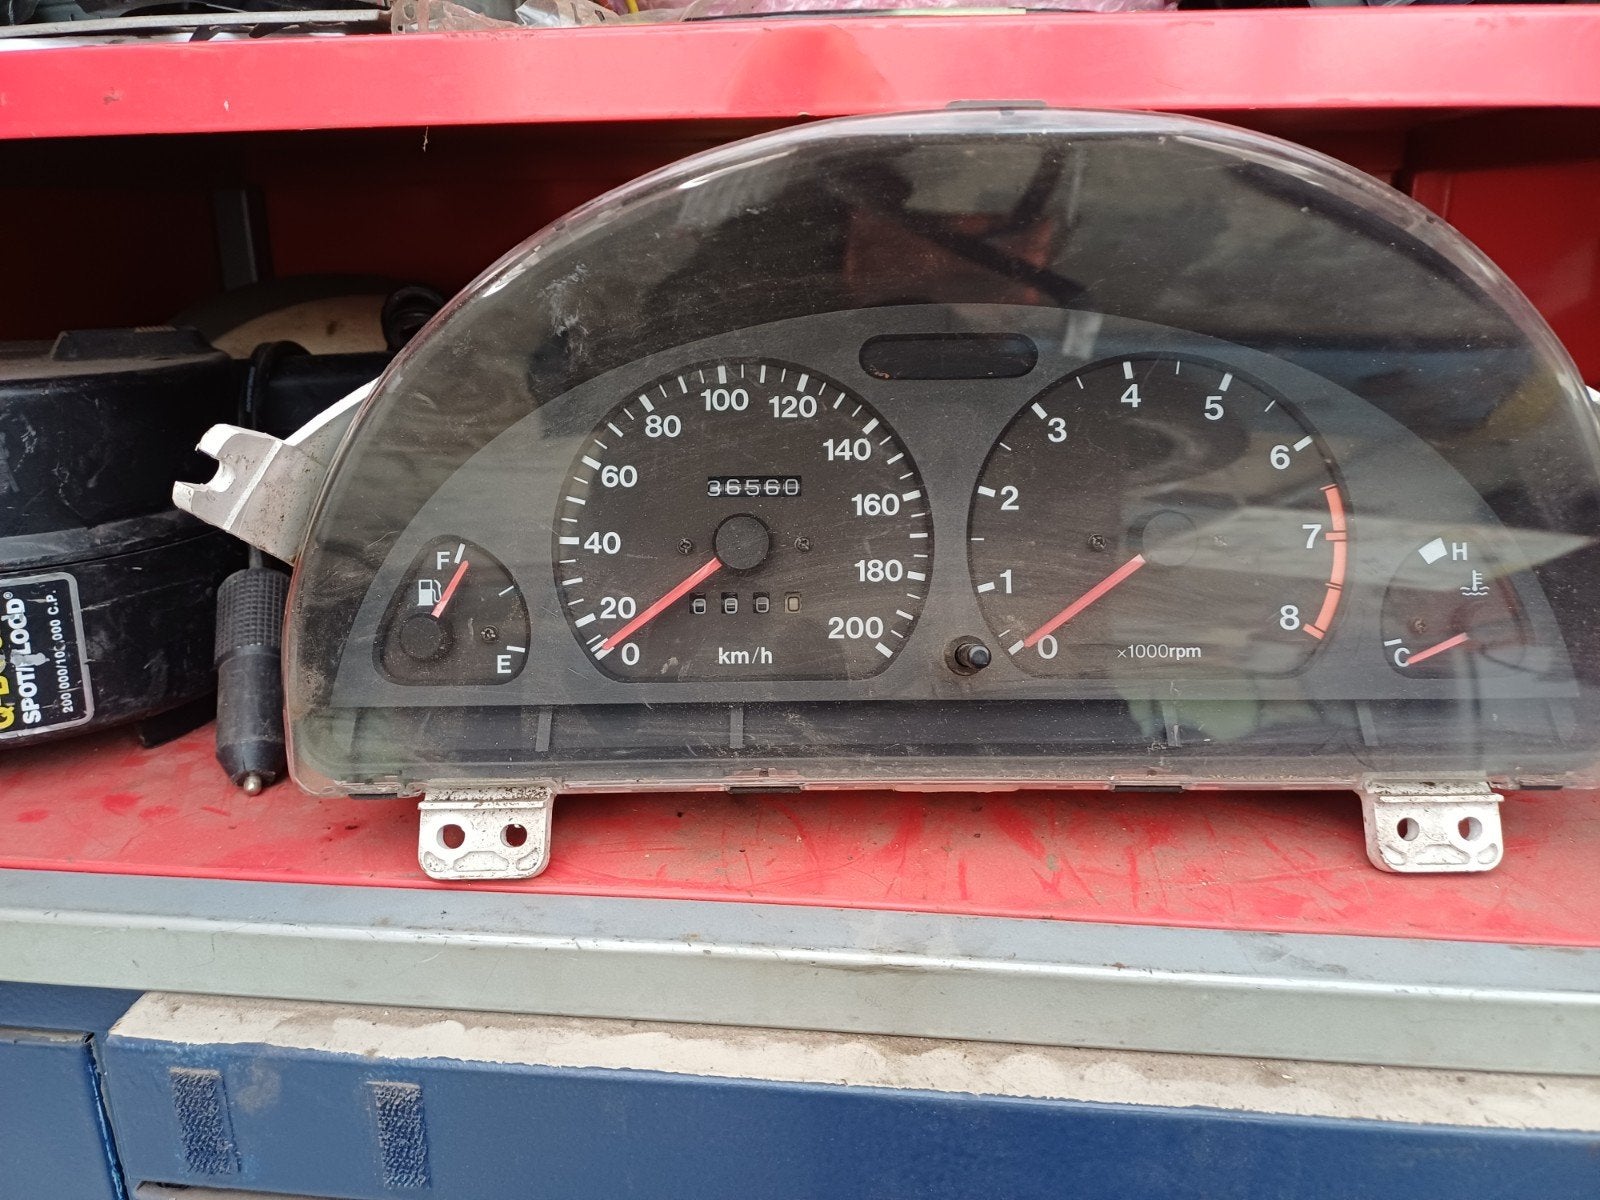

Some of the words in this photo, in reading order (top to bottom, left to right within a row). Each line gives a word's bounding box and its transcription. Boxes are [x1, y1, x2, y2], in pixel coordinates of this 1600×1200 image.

[700, 388, 749, 412] 100
[768, 395, 818, 418] 120
[1120, 383, 1142, 408] 4
[1203, 395, 1224, 420] 5
[644, 414, 682, 438] 80
[1046, 416, 1068, 443] 3
[822, 438, 872, 461] 140
[1270, 444, 1291, 469] 6
[600, 464, 639, 488] 60
[707, 478, 799, 497] 36560
[851, 493, 900, 516] 160
[1000, 485, 1020, 511] 2
[583, 531, 622, 555] 40
[1301, 523, 1322, 549] 7
[436, 551, 451, 570] F
[1451, 542, 1468, 561] H
[854, 559, 903, 583] 180
[1000, 569, 1013, 594] 1
[46, 590, 60, 615] C.P.
[599, 596, 637, 619] 20
[827, 616, 884, 640] 200
[1279, 604, 1301, 631] 8
[621, 643, 640, 667] 0
[718, 646, 774, 665] km/h
[1037, 634, 1058, 660] 0
[1393, 647, 1411, 668] C
[496, 654, 512, 674] E
